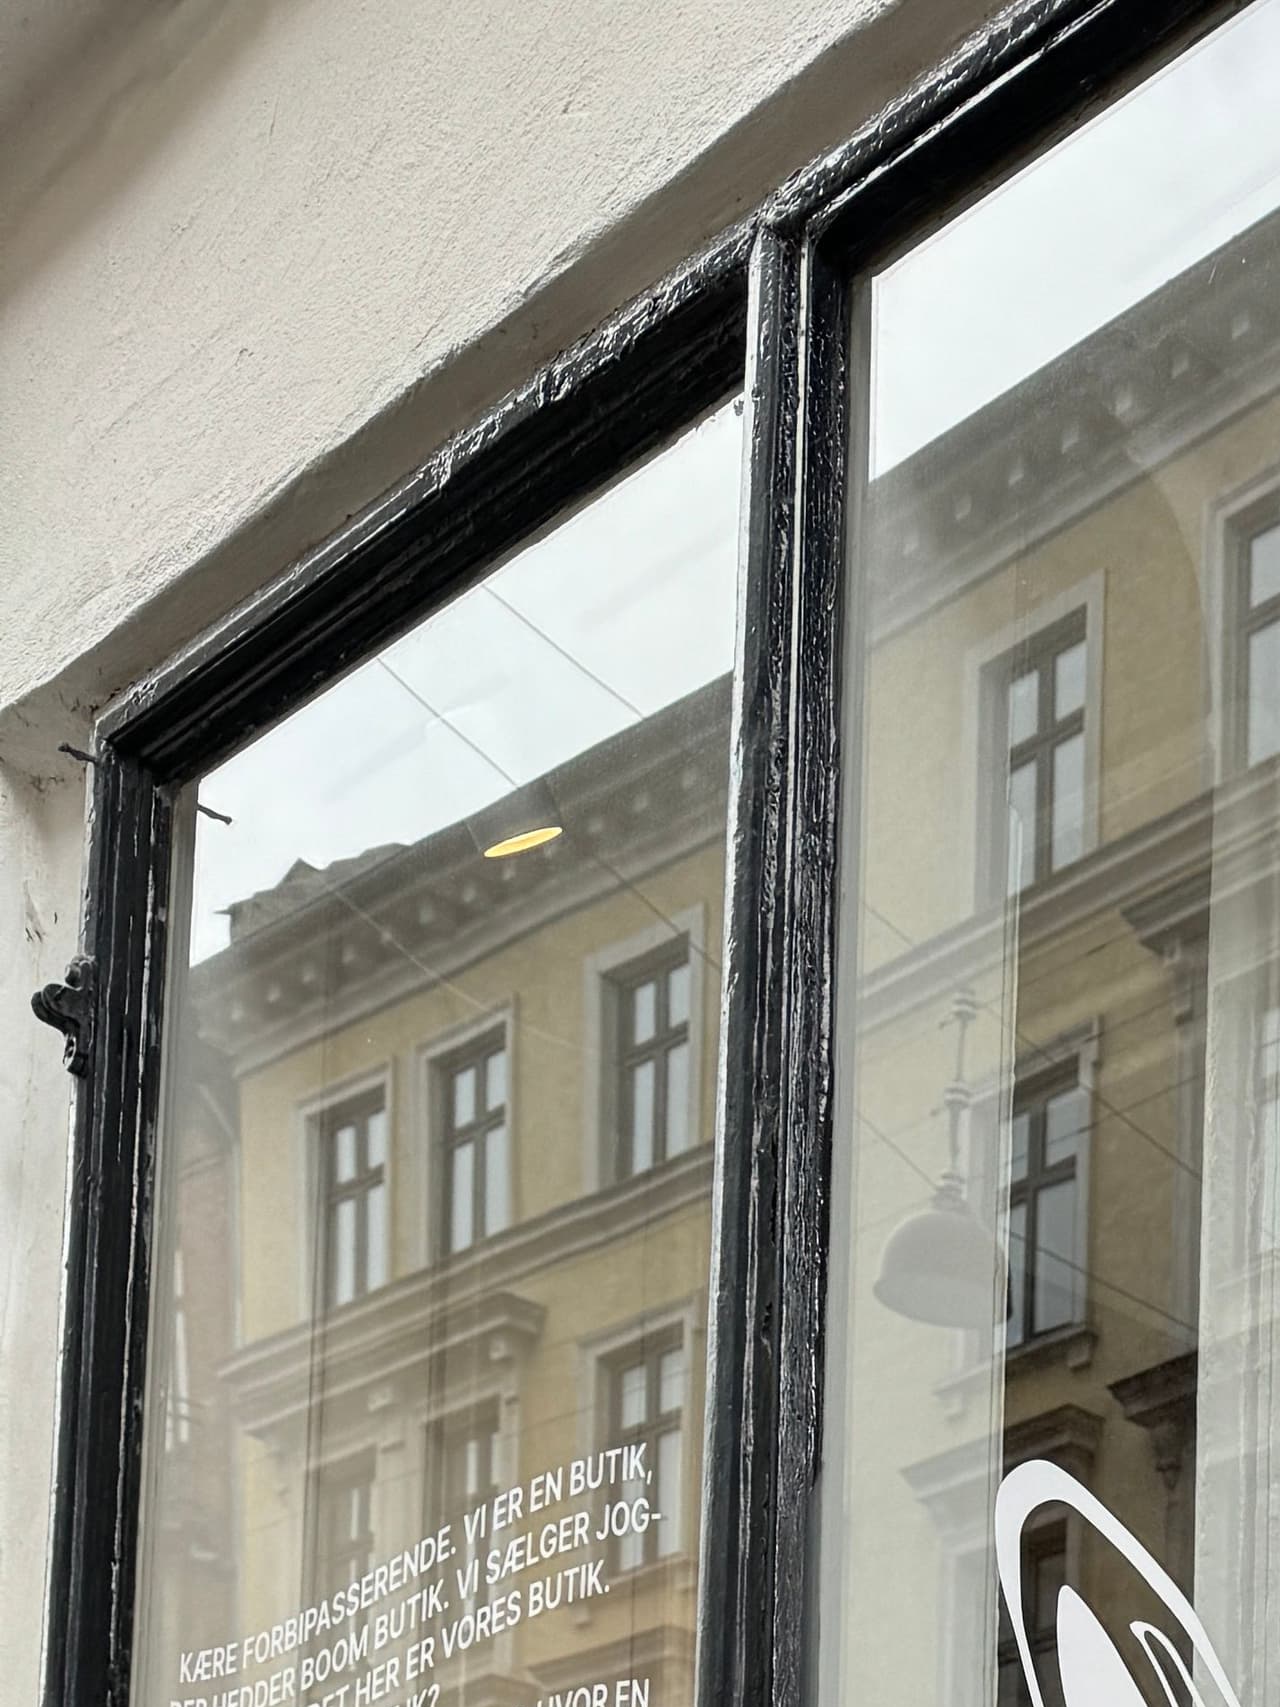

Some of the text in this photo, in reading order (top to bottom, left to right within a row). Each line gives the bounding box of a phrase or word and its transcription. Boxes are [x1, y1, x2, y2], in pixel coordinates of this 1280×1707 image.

[179, 1442, 652, 1684] KÆRE FORBIPASSERENDE. VI ER EN BUTIK,
[300, 1624, 370, 1691] BOOM
[373, 1577, 450, 1650] BUTIK.
[456, 1558, 480, 1601] VI
[484, 1511, 591, 1586] SÆLGER
[595, 1497, 662, 1541] JOG-
